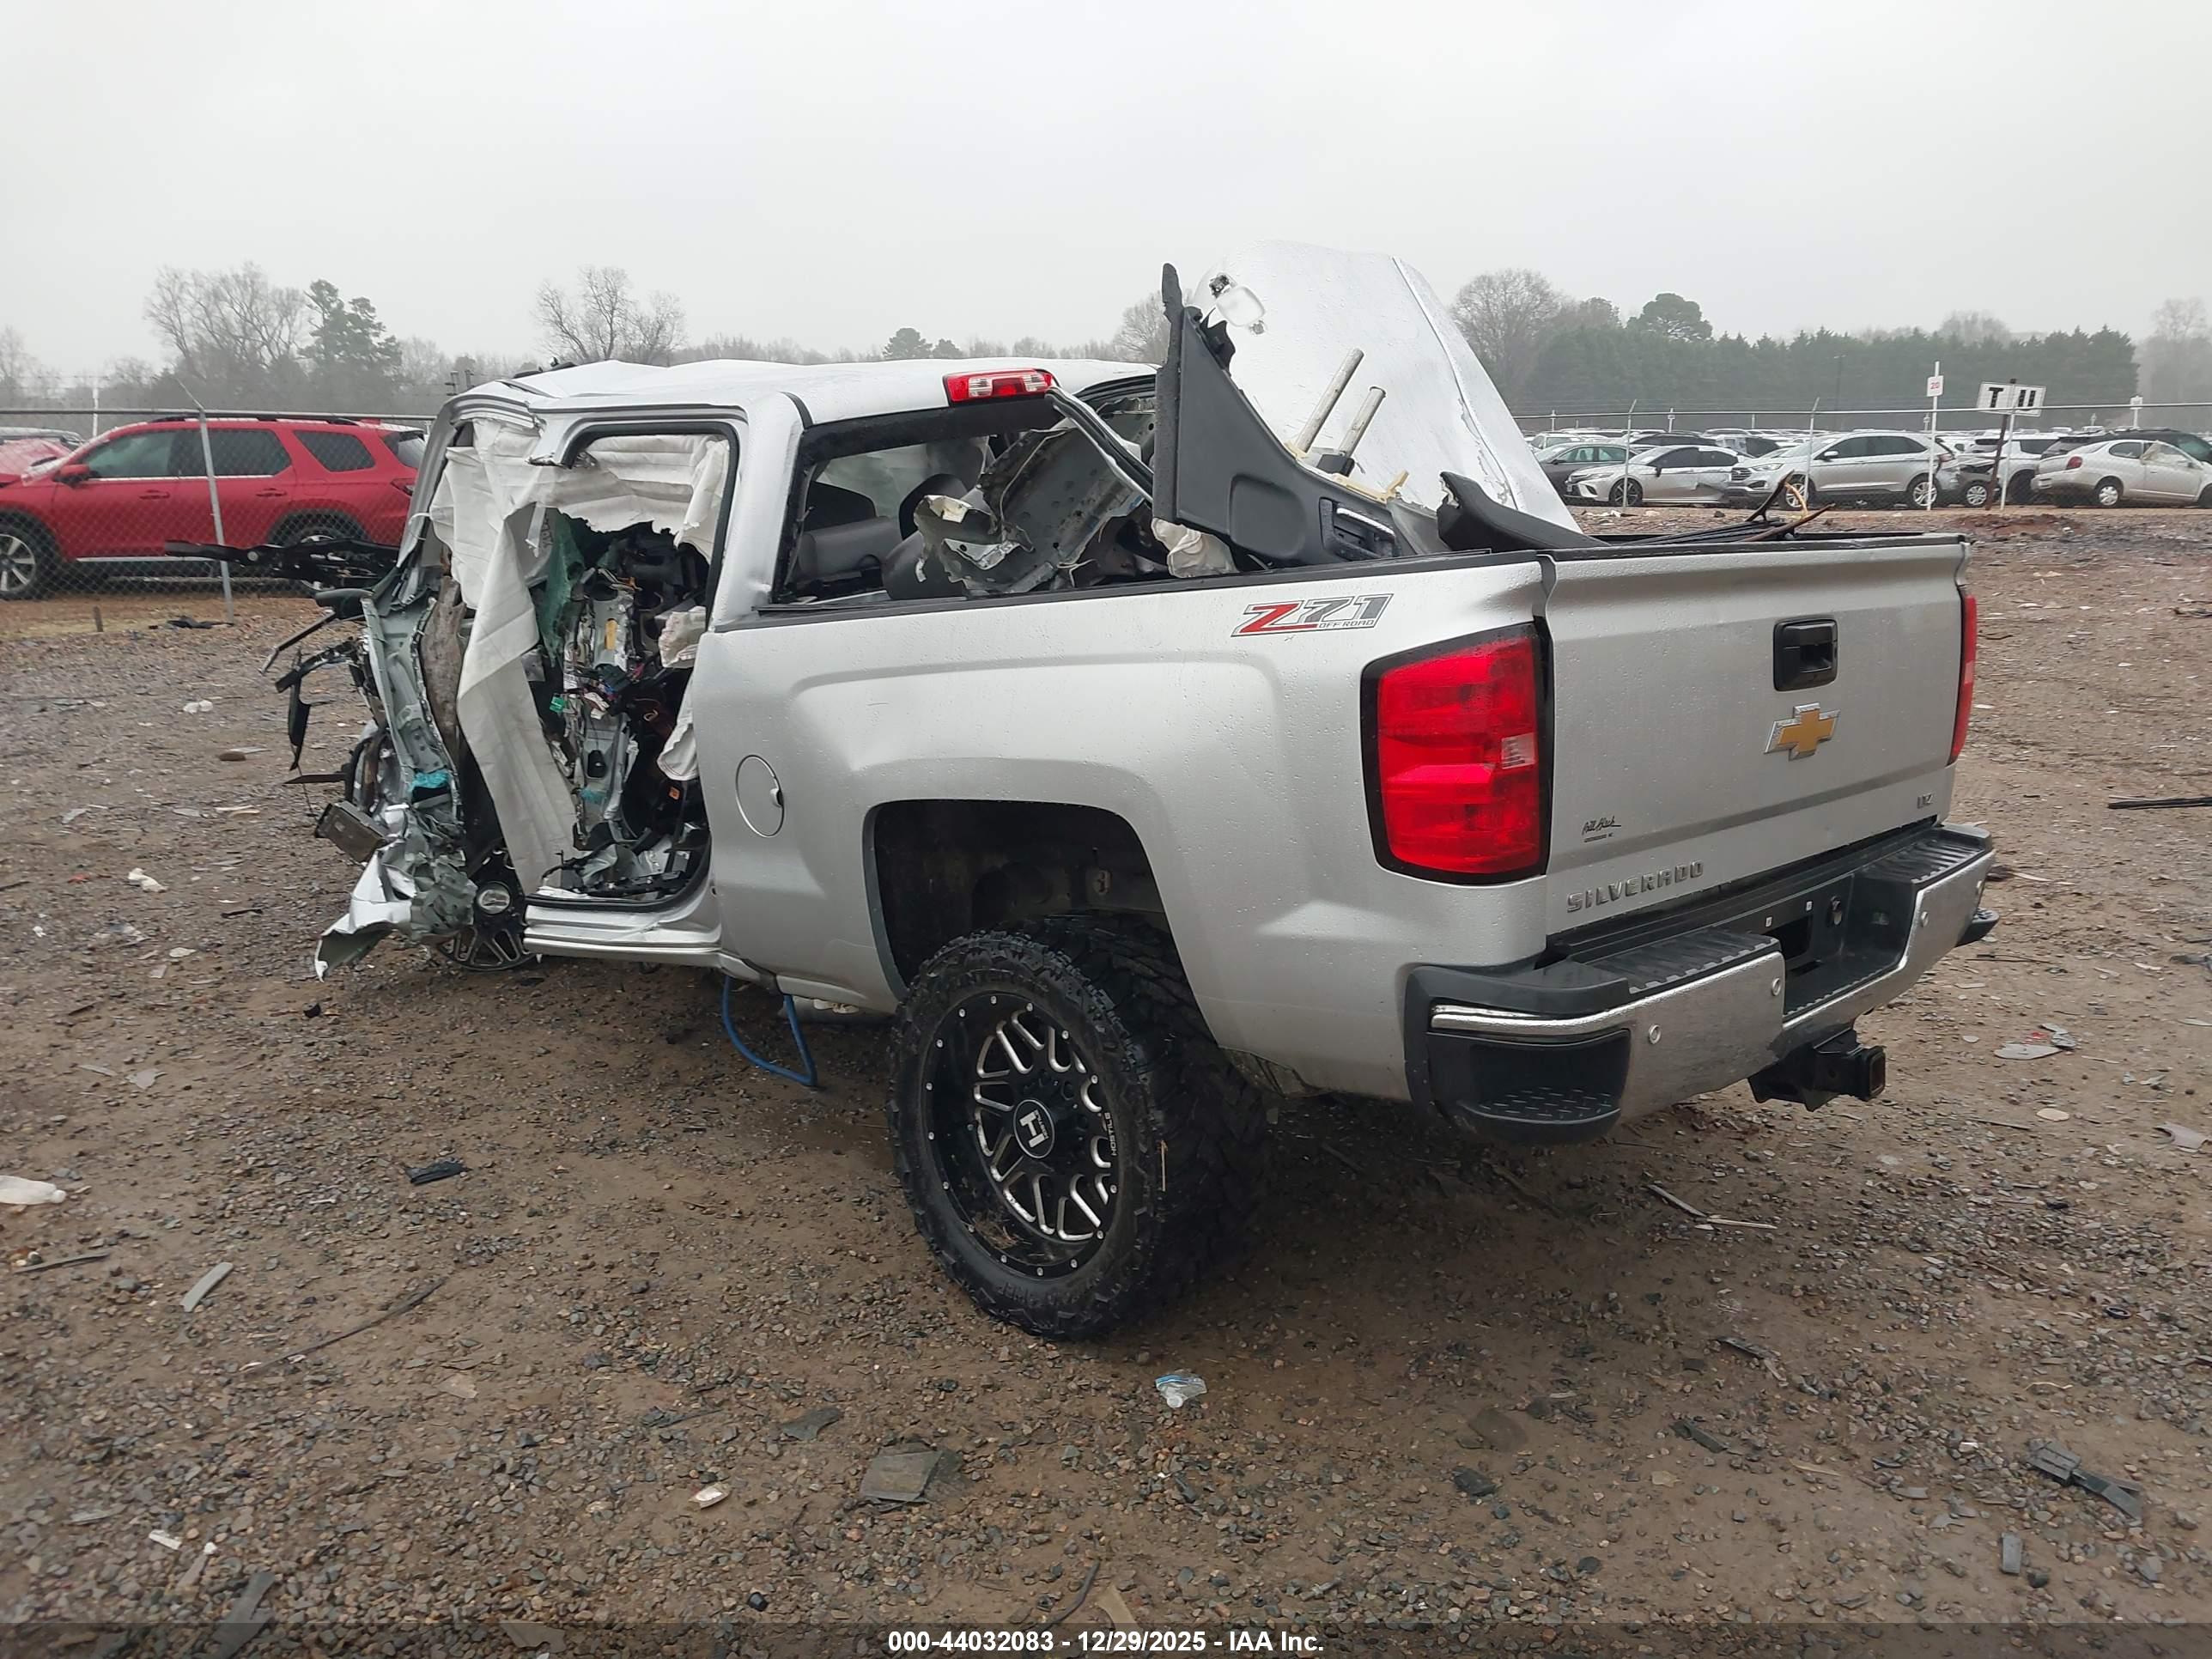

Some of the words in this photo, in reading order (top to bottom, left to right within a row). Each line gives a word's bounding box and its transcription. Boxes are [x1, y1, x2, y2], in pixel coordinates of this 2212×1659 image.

[1988, 386, 2004, 408] T
[1231, 594, 1394, 636] Z71
[1567, 860, 1705, 913] SILVERADO
[1104, 1112, 1117, 1156] HOSTILE
